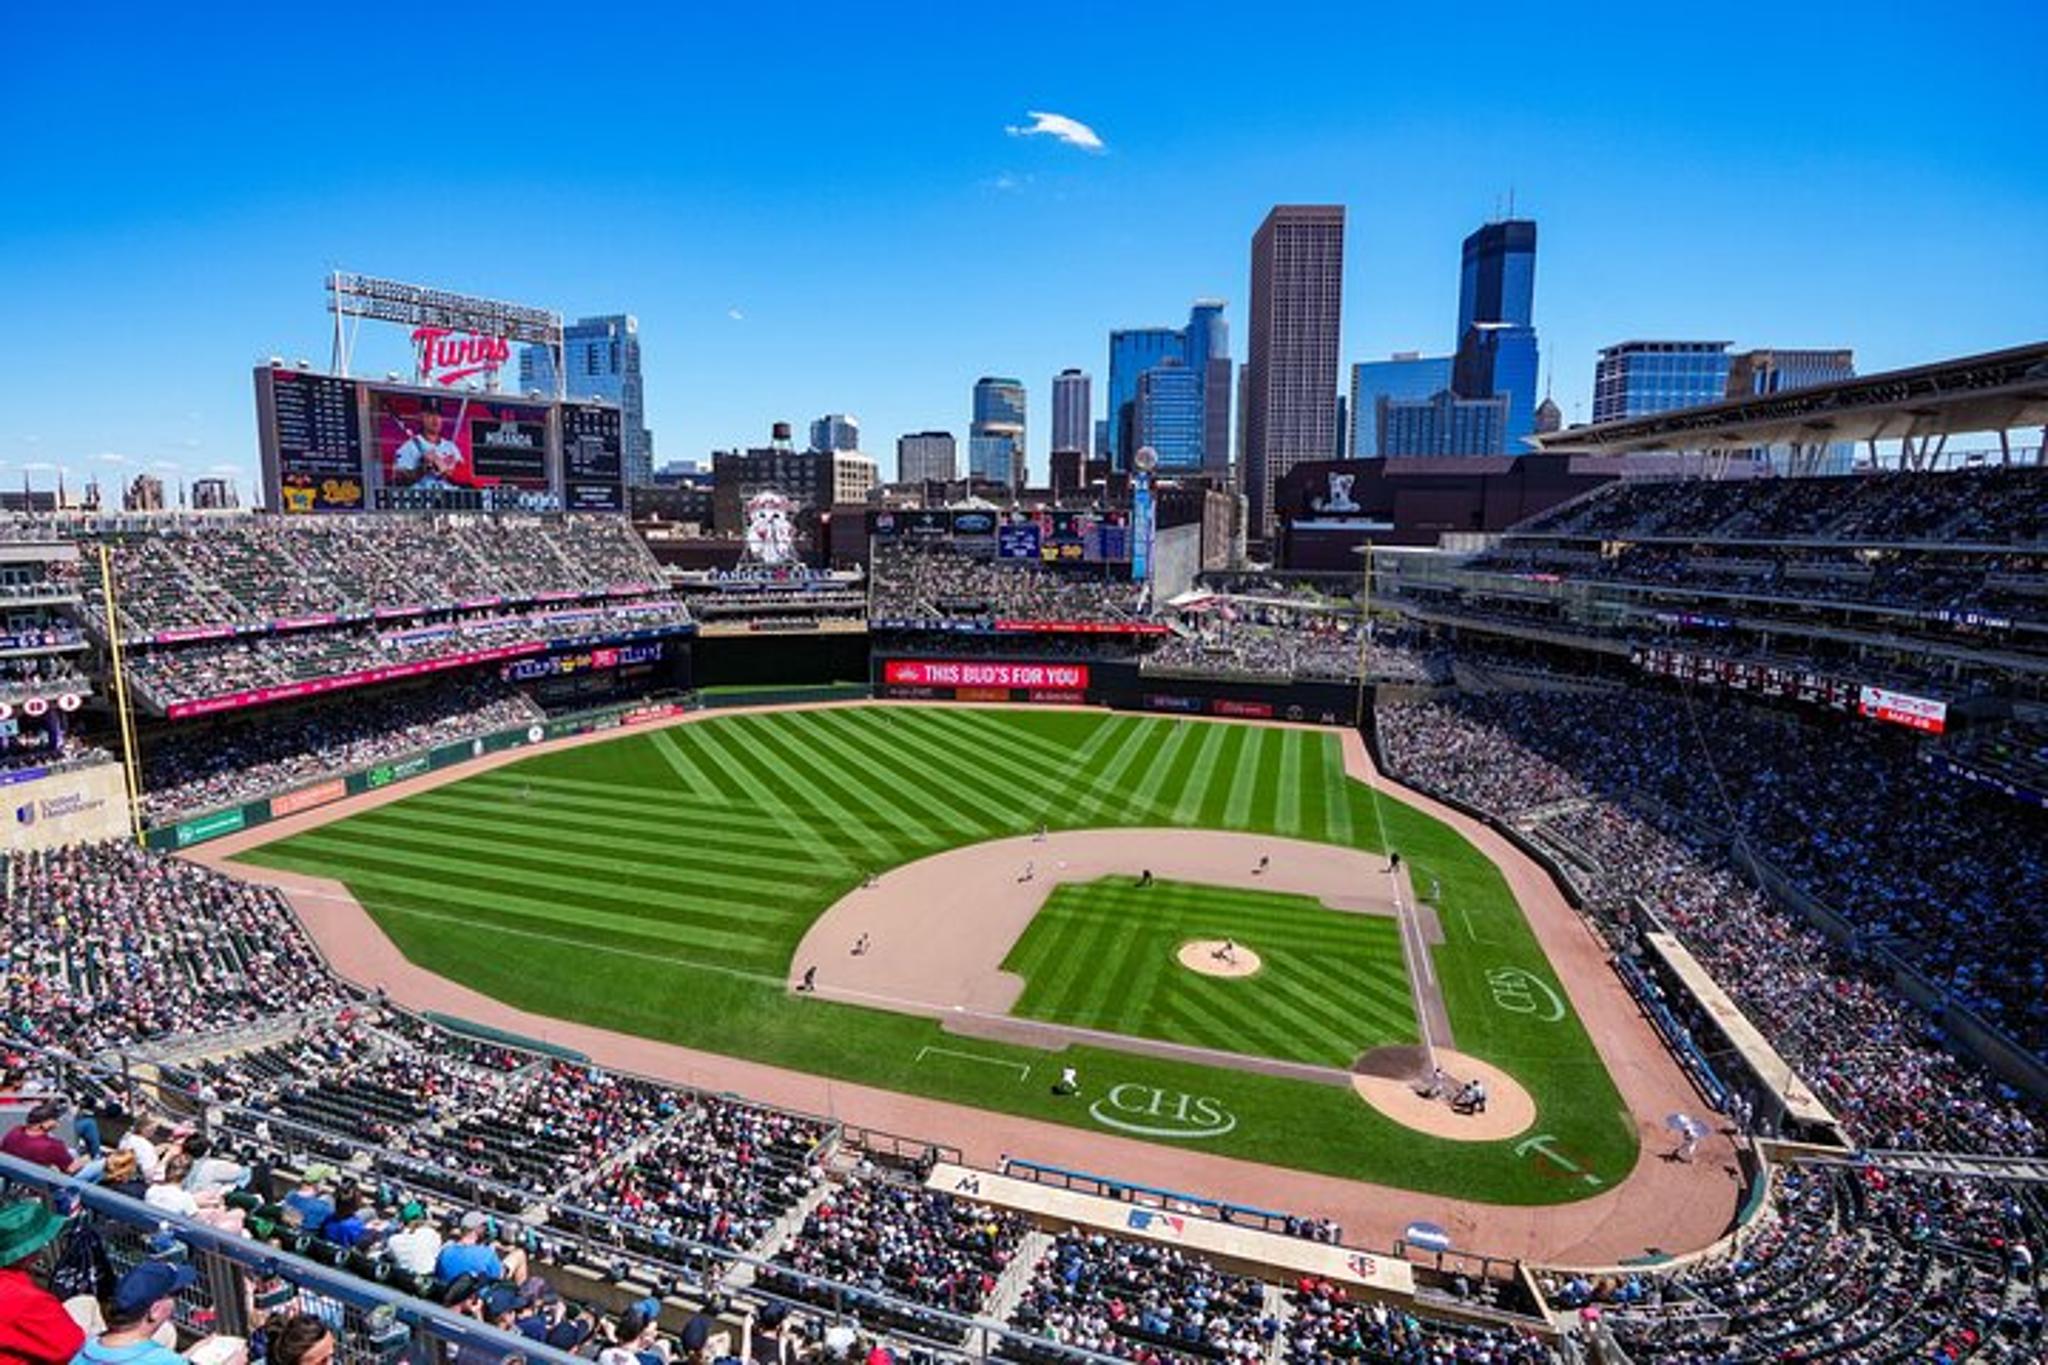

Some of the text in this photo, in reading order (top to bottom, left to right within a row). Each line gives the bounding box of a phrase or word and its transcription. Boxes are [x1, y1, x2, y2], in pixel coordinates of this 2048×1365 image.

[412, 328, 510, 384] Twins
[924, 664, 1079, 686] THIS BUD'S FOR YOU
[1109, 1082, 1222, 1126] CHS
